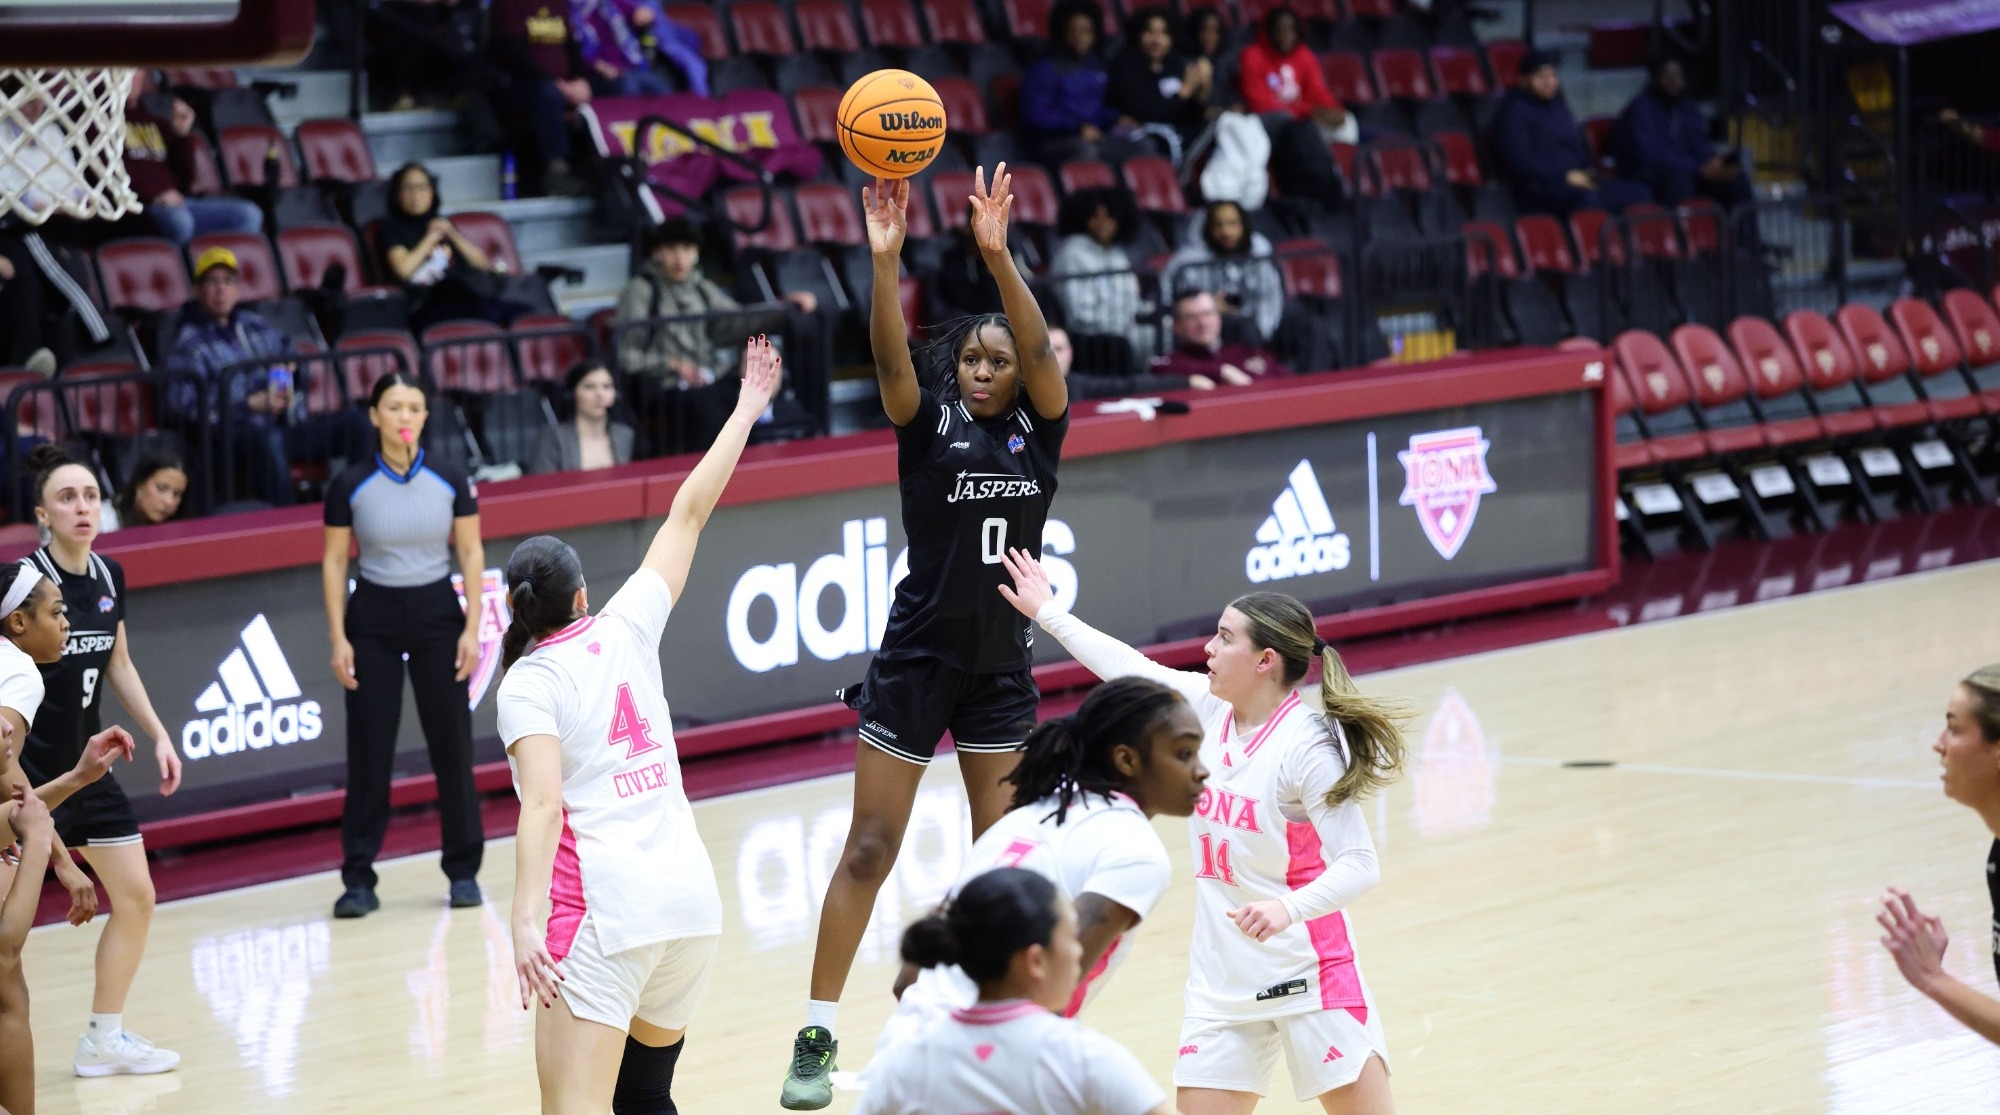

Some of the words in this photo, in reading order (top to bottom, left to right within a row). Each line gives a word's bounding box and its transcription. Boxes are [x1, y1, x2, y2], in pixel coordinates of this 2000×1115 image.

[879, 111, 943, 131] Wilson
[885, 147, 935, 163] NCAA
[982, 517, 1008, 564] 0
[1246, 533, 1351, 583] adidas
[726, 516, 1078, 673] adis
[61, 635, 116, 656] ASPER
[82, 667, 99, 709] 9
[182, 697, 323, 761] adidas
[608, 682, 663, 760] 4
[613, 762, 668, 798] CIVER
[1195, 784, 1264, 834] ONA
[1196, 833, 1239, 887] 14
